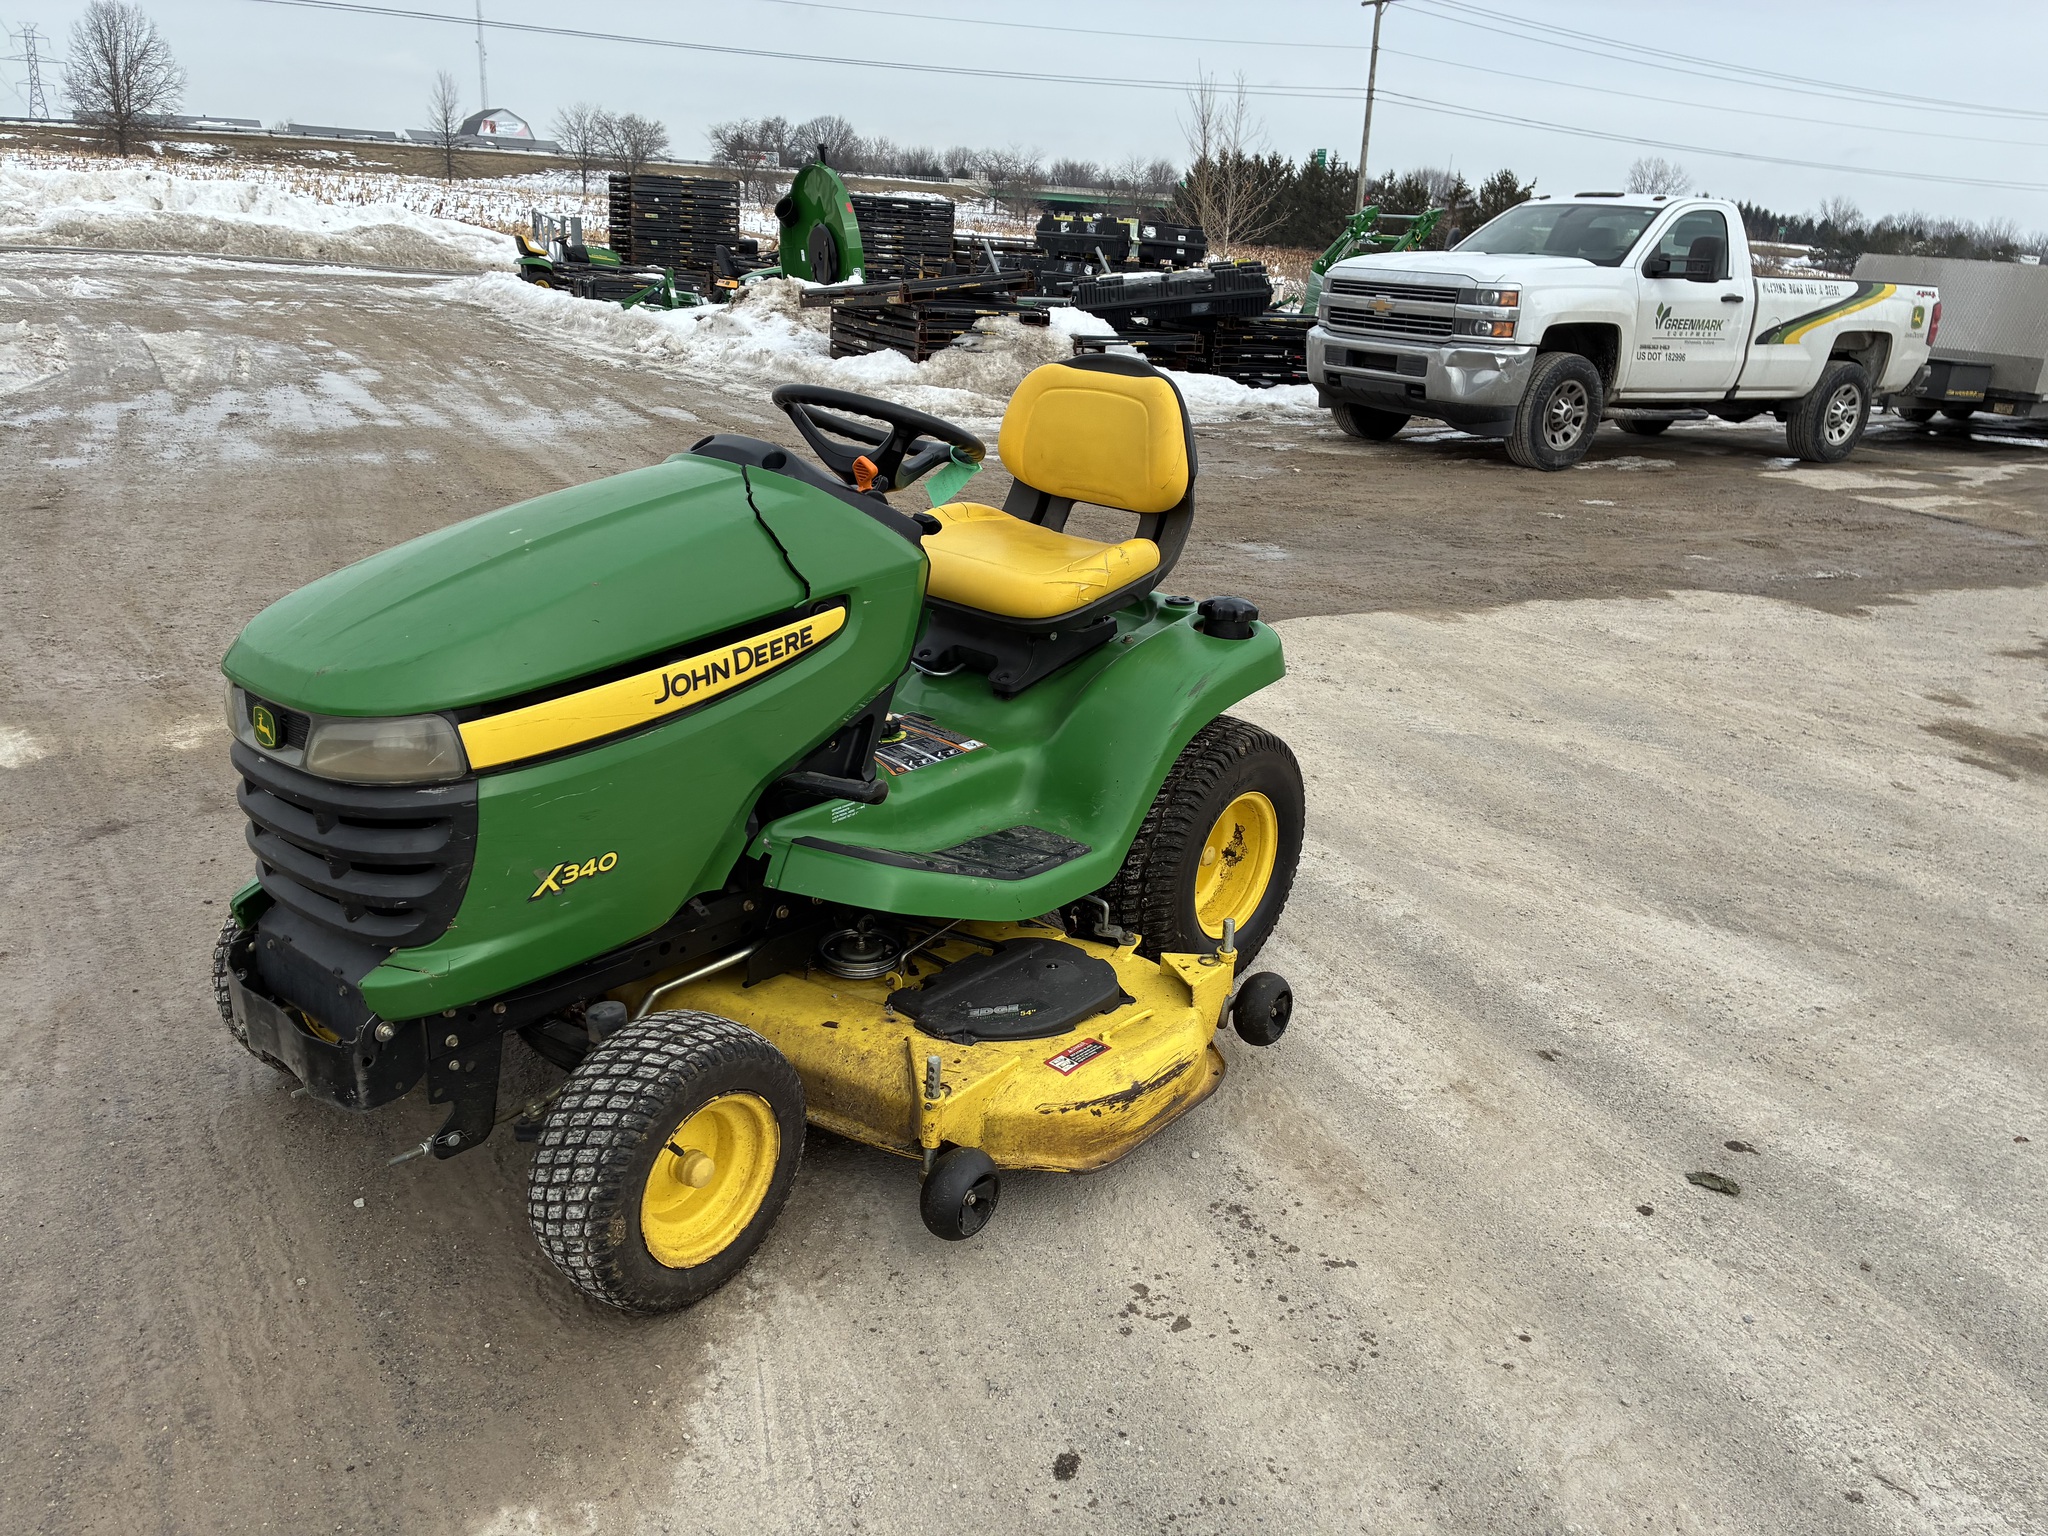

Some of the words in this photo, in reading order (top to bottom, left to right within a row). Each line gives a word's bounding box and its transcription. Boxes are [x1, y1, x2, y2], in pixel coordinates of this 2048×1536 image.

[1664, 318, 1724, 331] GREENMARK
[1636, 351, 1646, 361] US
[1647, 351, 1661, 361] DOT
[654, 658, 730, 704] JOHN
[732, 625, 814, 676] DEERE
[528, 851, 619, 901] X340
